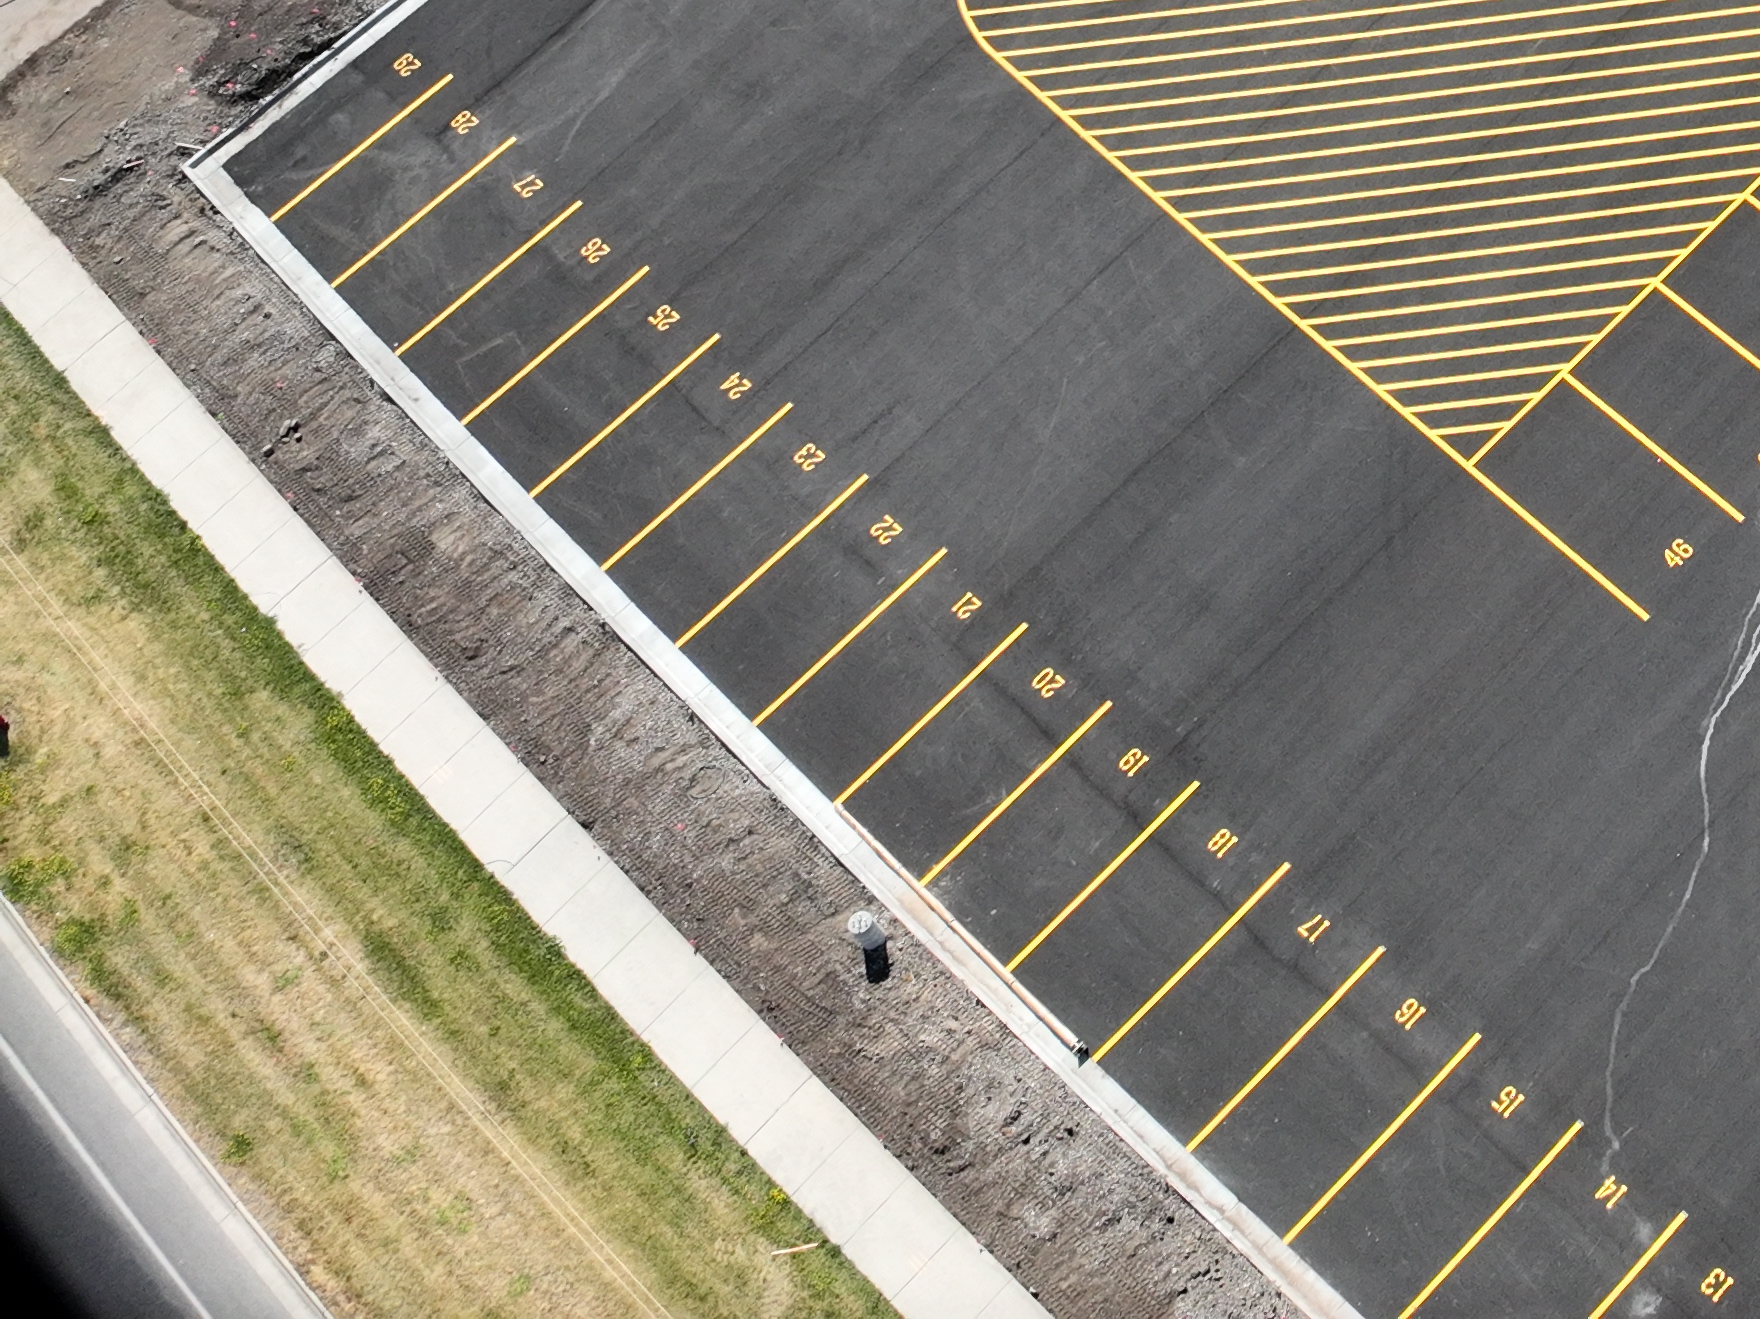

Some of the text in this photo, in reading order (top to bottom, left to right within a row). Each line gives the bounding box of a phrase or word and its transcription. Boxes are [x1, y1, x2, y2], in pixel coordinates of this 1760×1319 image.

[393, 53, 421, 76] 29
[512, 175, 543, 198] 27
[648, 305, 680, 331] 25
[720, 373, 752, 400] 24
[870, 514, 903, 545] 22
[1665, 539, 1693, 568] 46
[1031, 667, 1066, 698] 20
[1207, 829, 1238, 859] 18
[1297, 915, 1330, 943] 17
[1394, 998, 1426, 1030] 16
[1491, 1086, 1525, 1119] 15
[1701, 1268, 1734, 1303] 13
